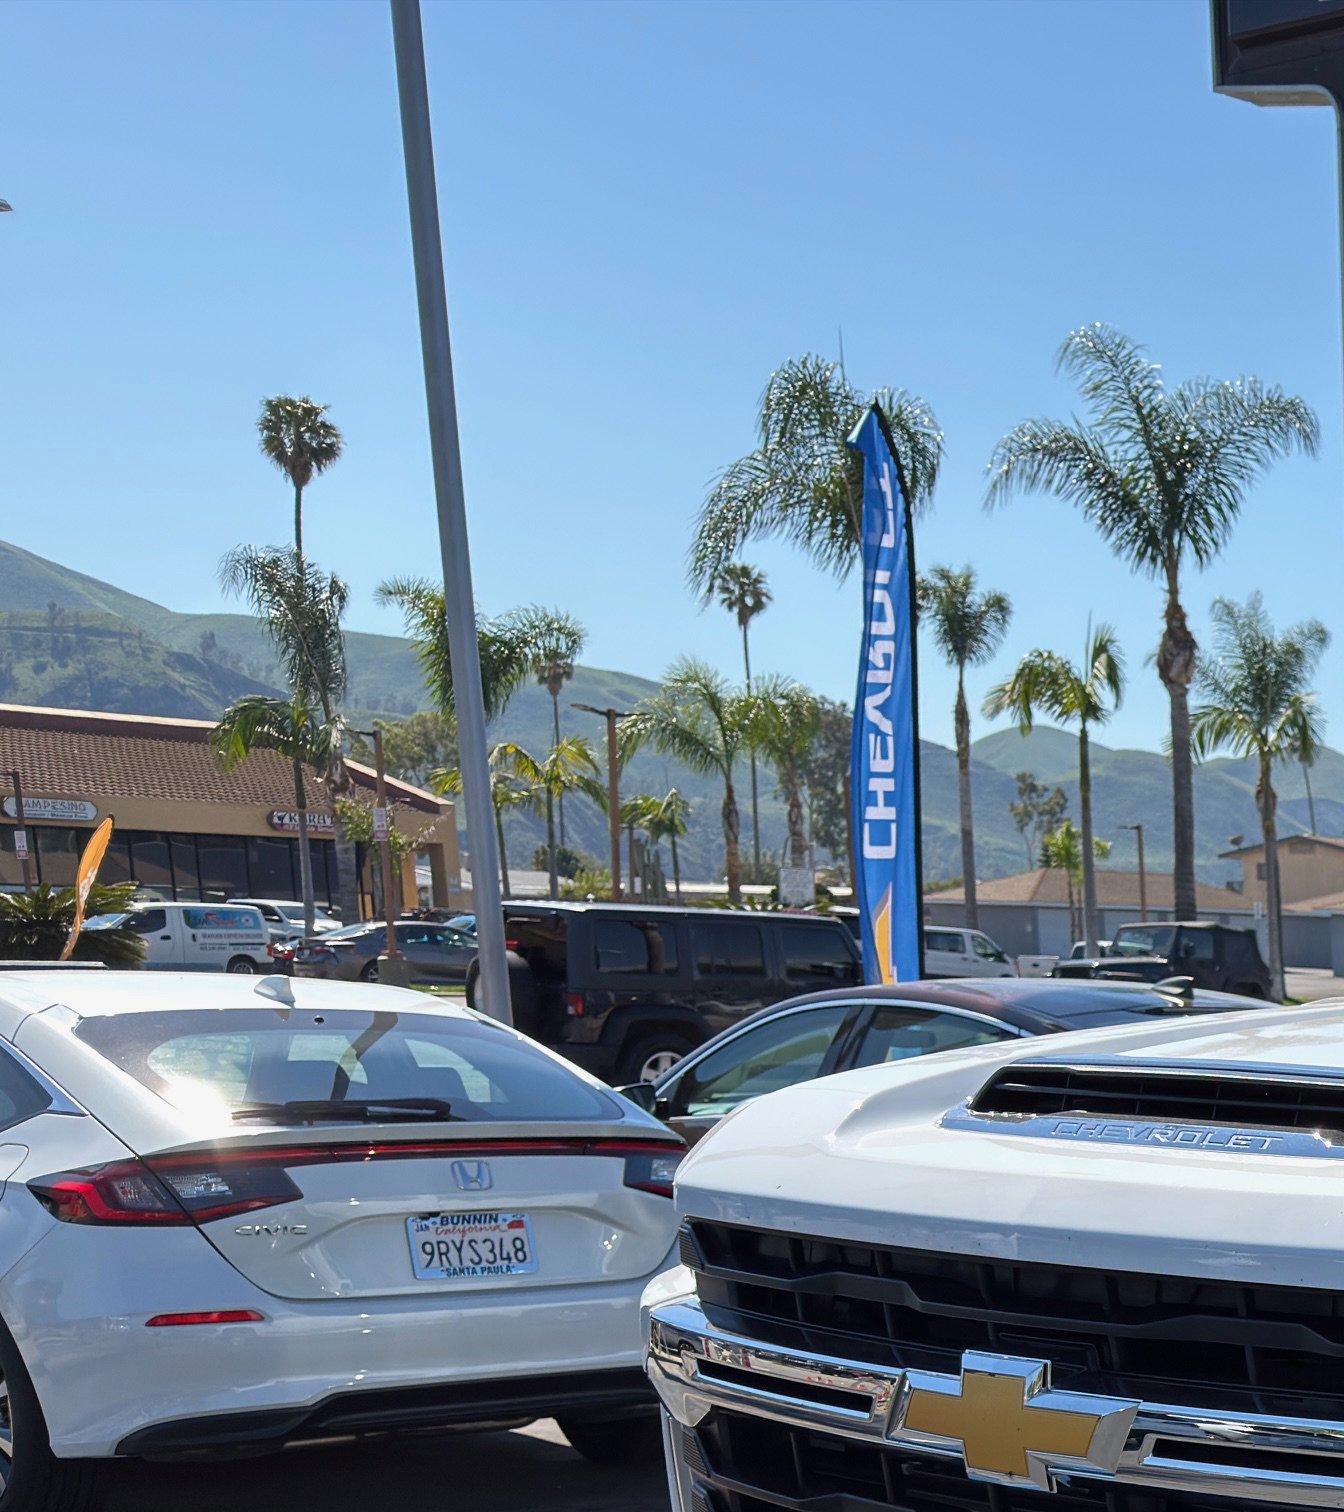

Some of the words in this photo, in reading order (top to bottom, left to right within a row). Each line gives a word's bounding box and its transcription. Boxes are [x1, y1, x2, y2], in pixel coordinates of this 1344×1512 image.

[23, 800, 87, 812] AMPESINO
[289, 812, 335, 825] KRAT
[1051, 1121, 1284, 1150] CHEVROLET
[440, 1213, 499, 1226] BUNNIN
[235, 1225, 308, 1236] CIVIC
[435, 1225, 508, 1237] California
[421, 1237, 527, 1268] 9RYS348
